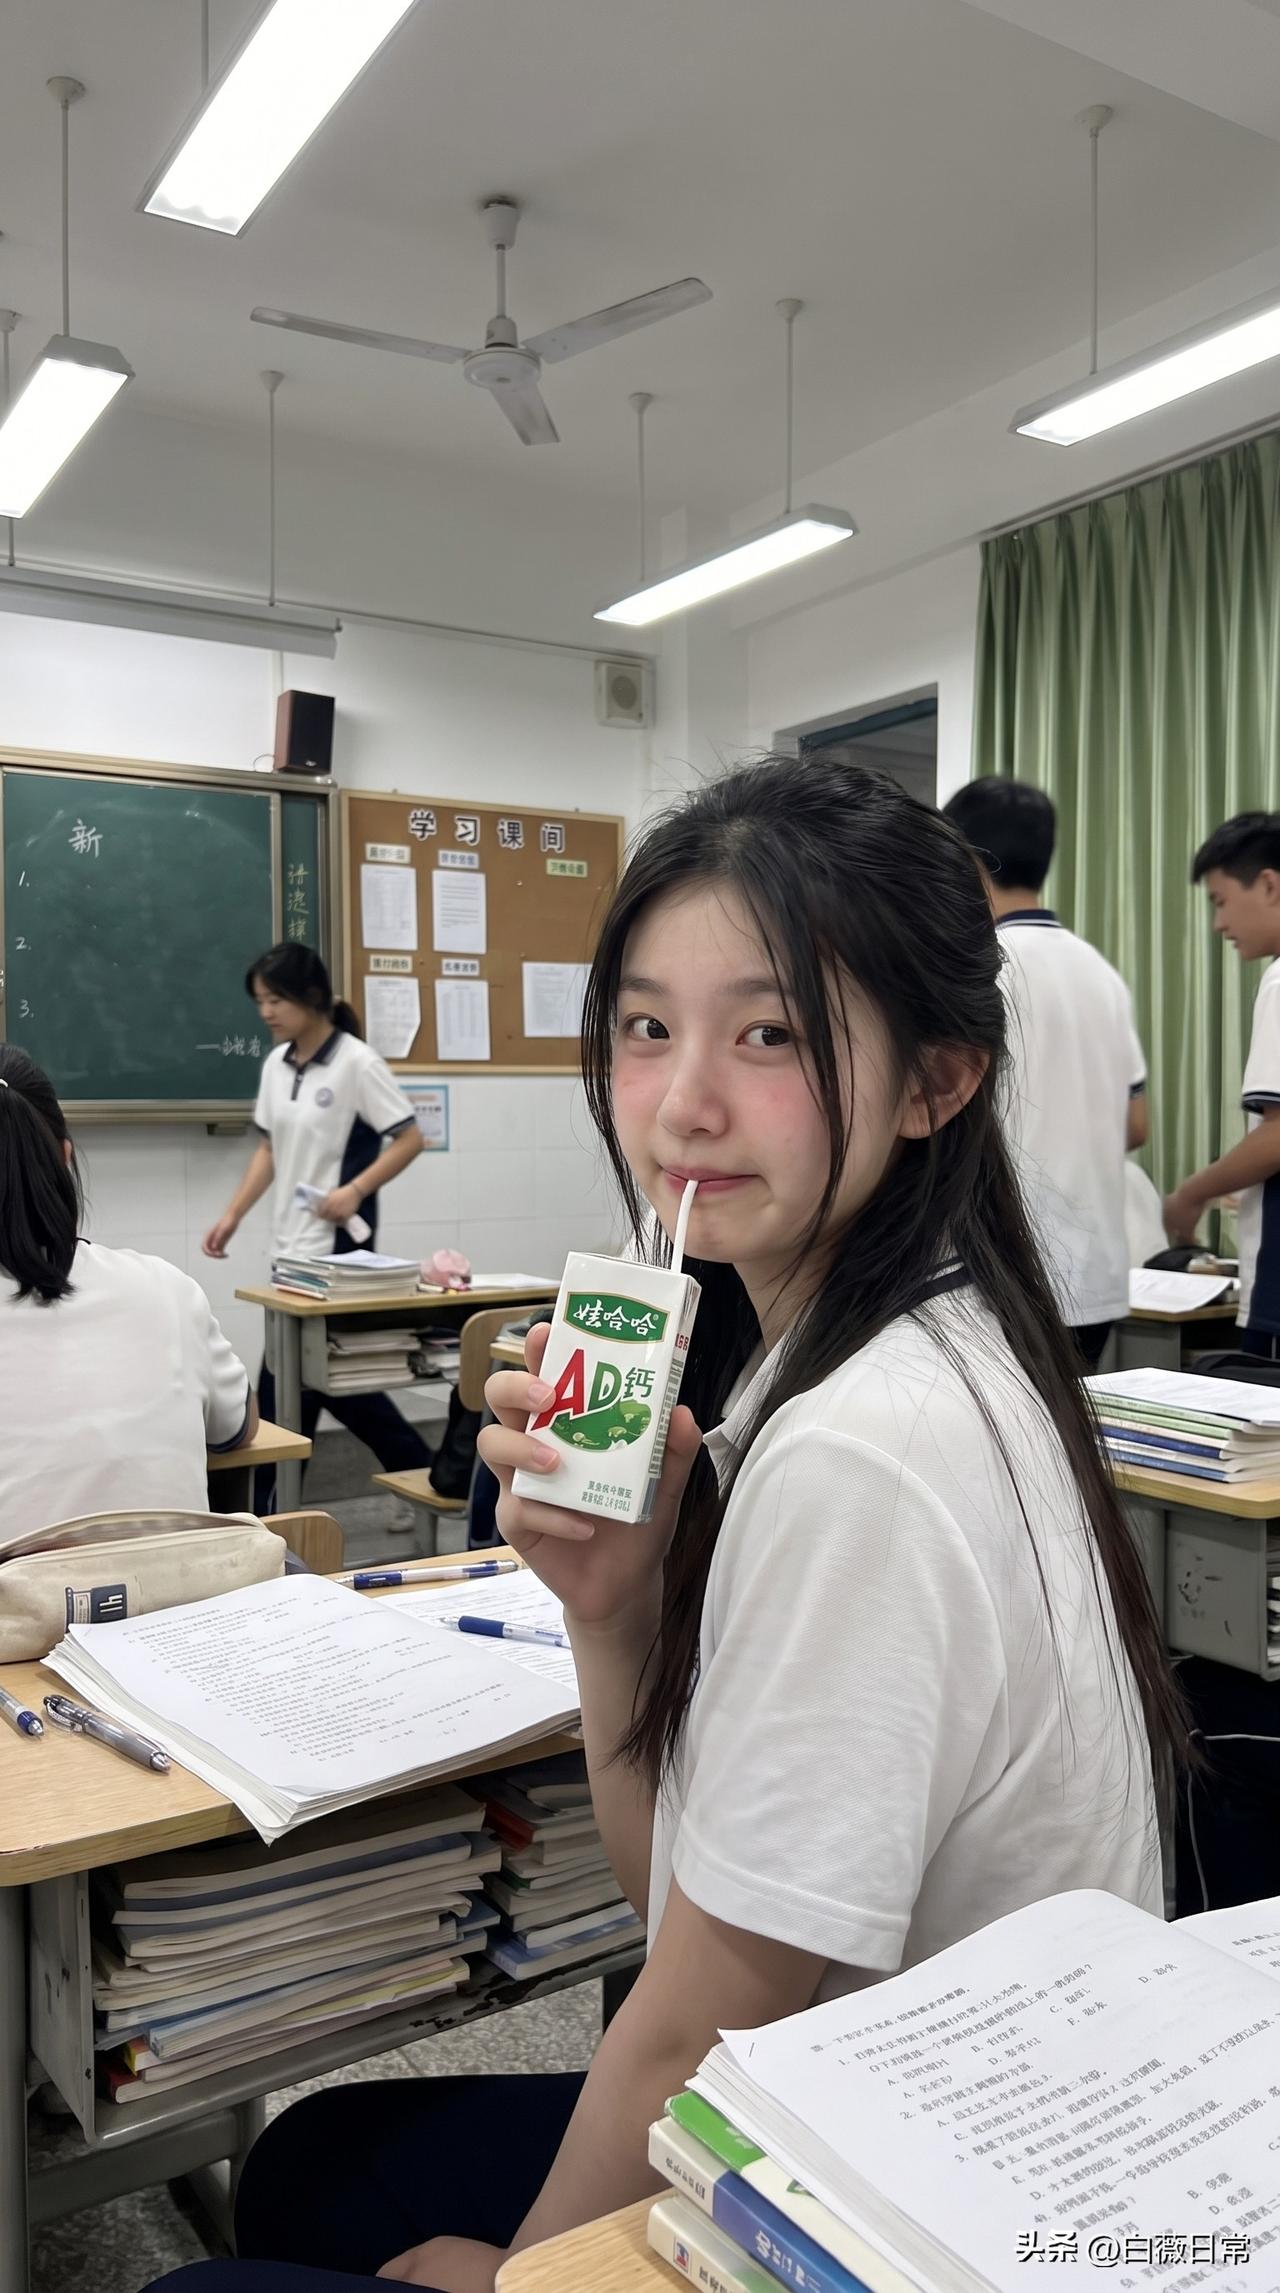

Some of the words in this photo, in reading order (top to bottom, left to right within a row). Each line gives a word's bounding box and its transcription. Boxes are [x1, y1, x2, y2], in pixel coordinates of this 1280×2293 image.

[68, 819, 103, 858] 新
[573, 1299, 656, 1336] 娃哈哈
